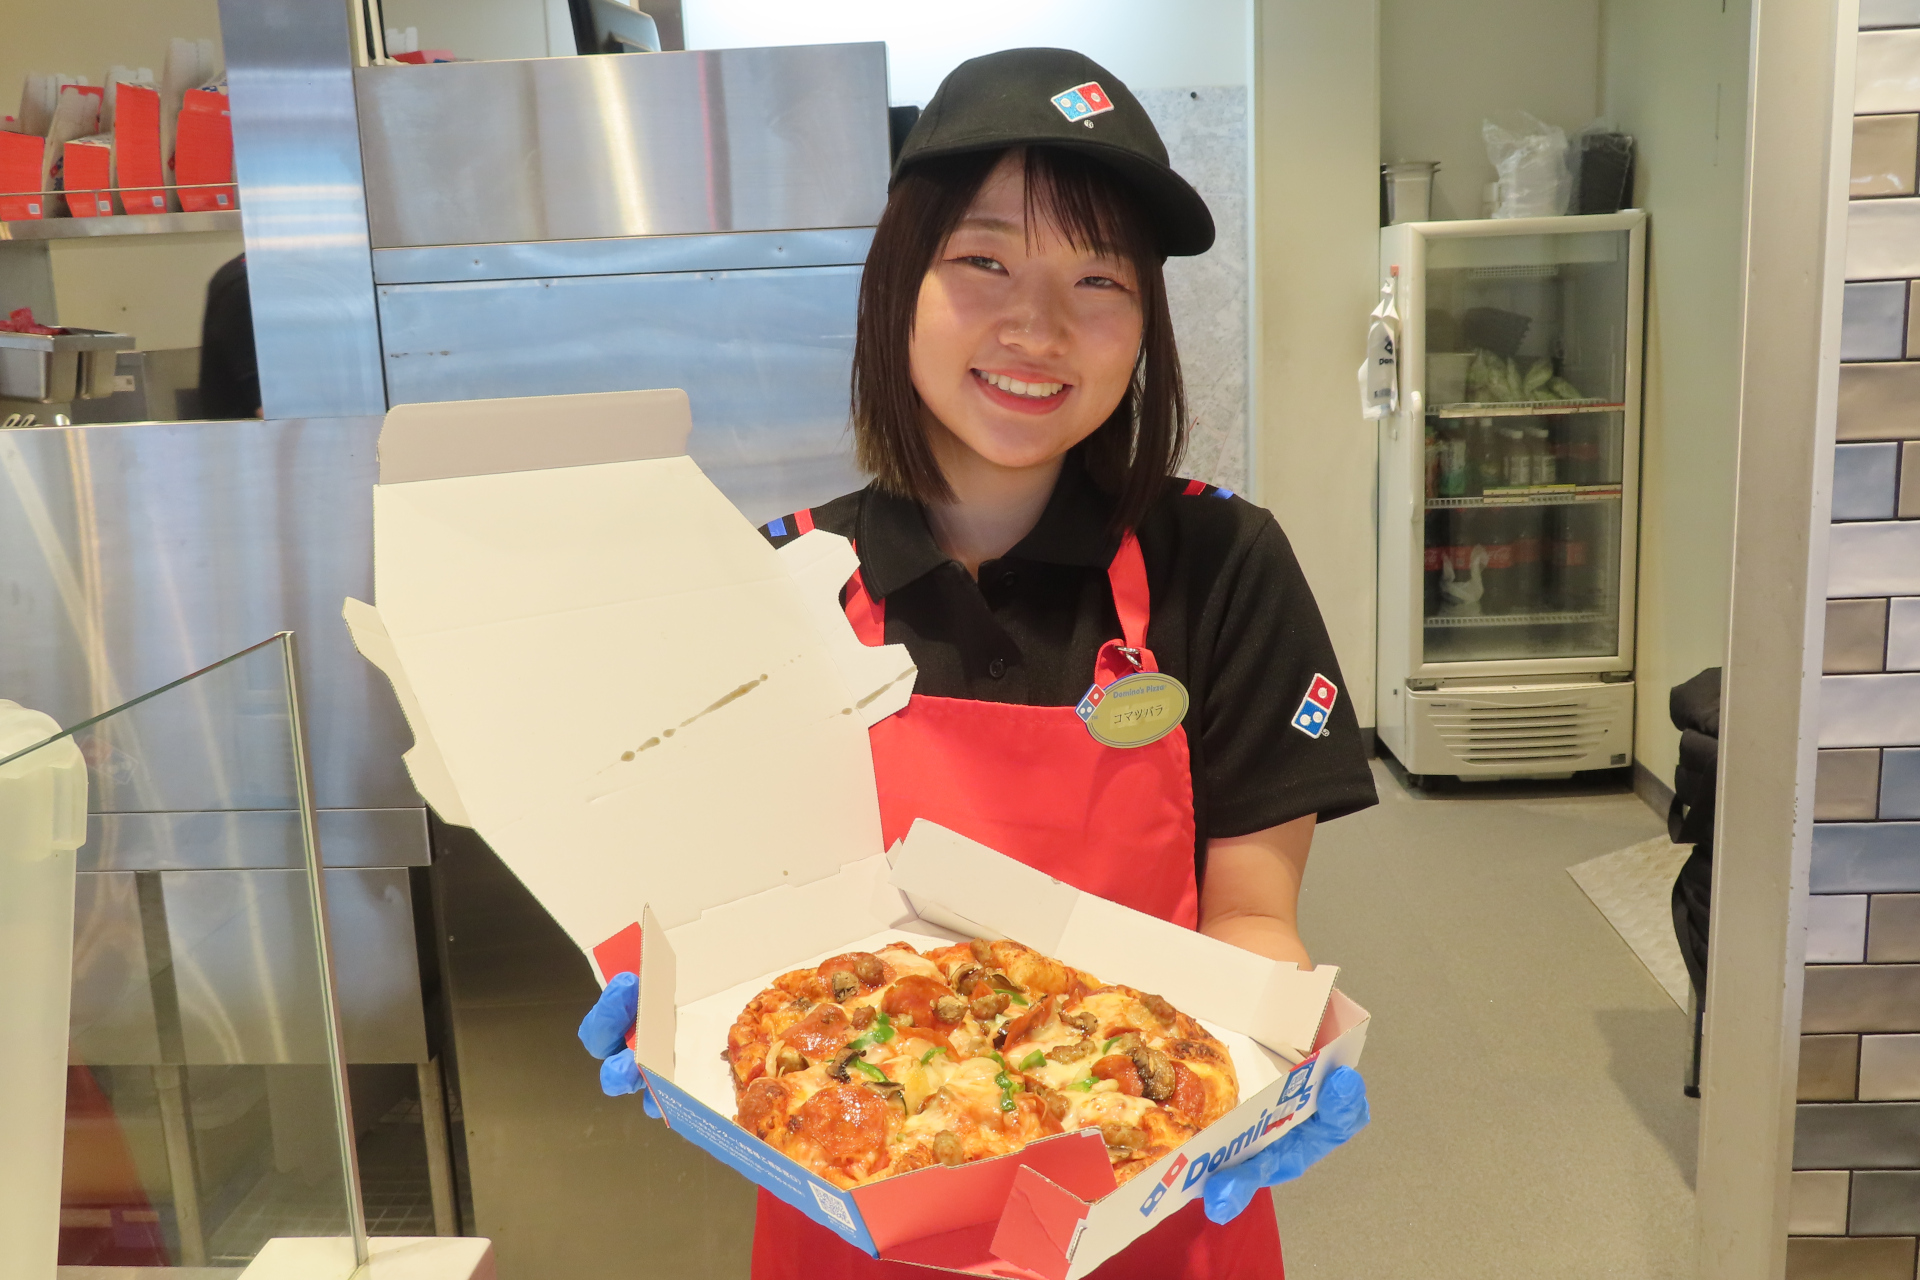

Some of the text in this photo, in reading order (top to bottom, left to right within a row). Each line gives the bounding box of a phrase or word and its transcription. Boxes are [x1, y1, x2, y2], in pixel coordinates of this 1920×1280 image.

[1113, 684, 1165, 699] Domino's Pizza
[1113, 704, 1164, 724] コマツバラ
